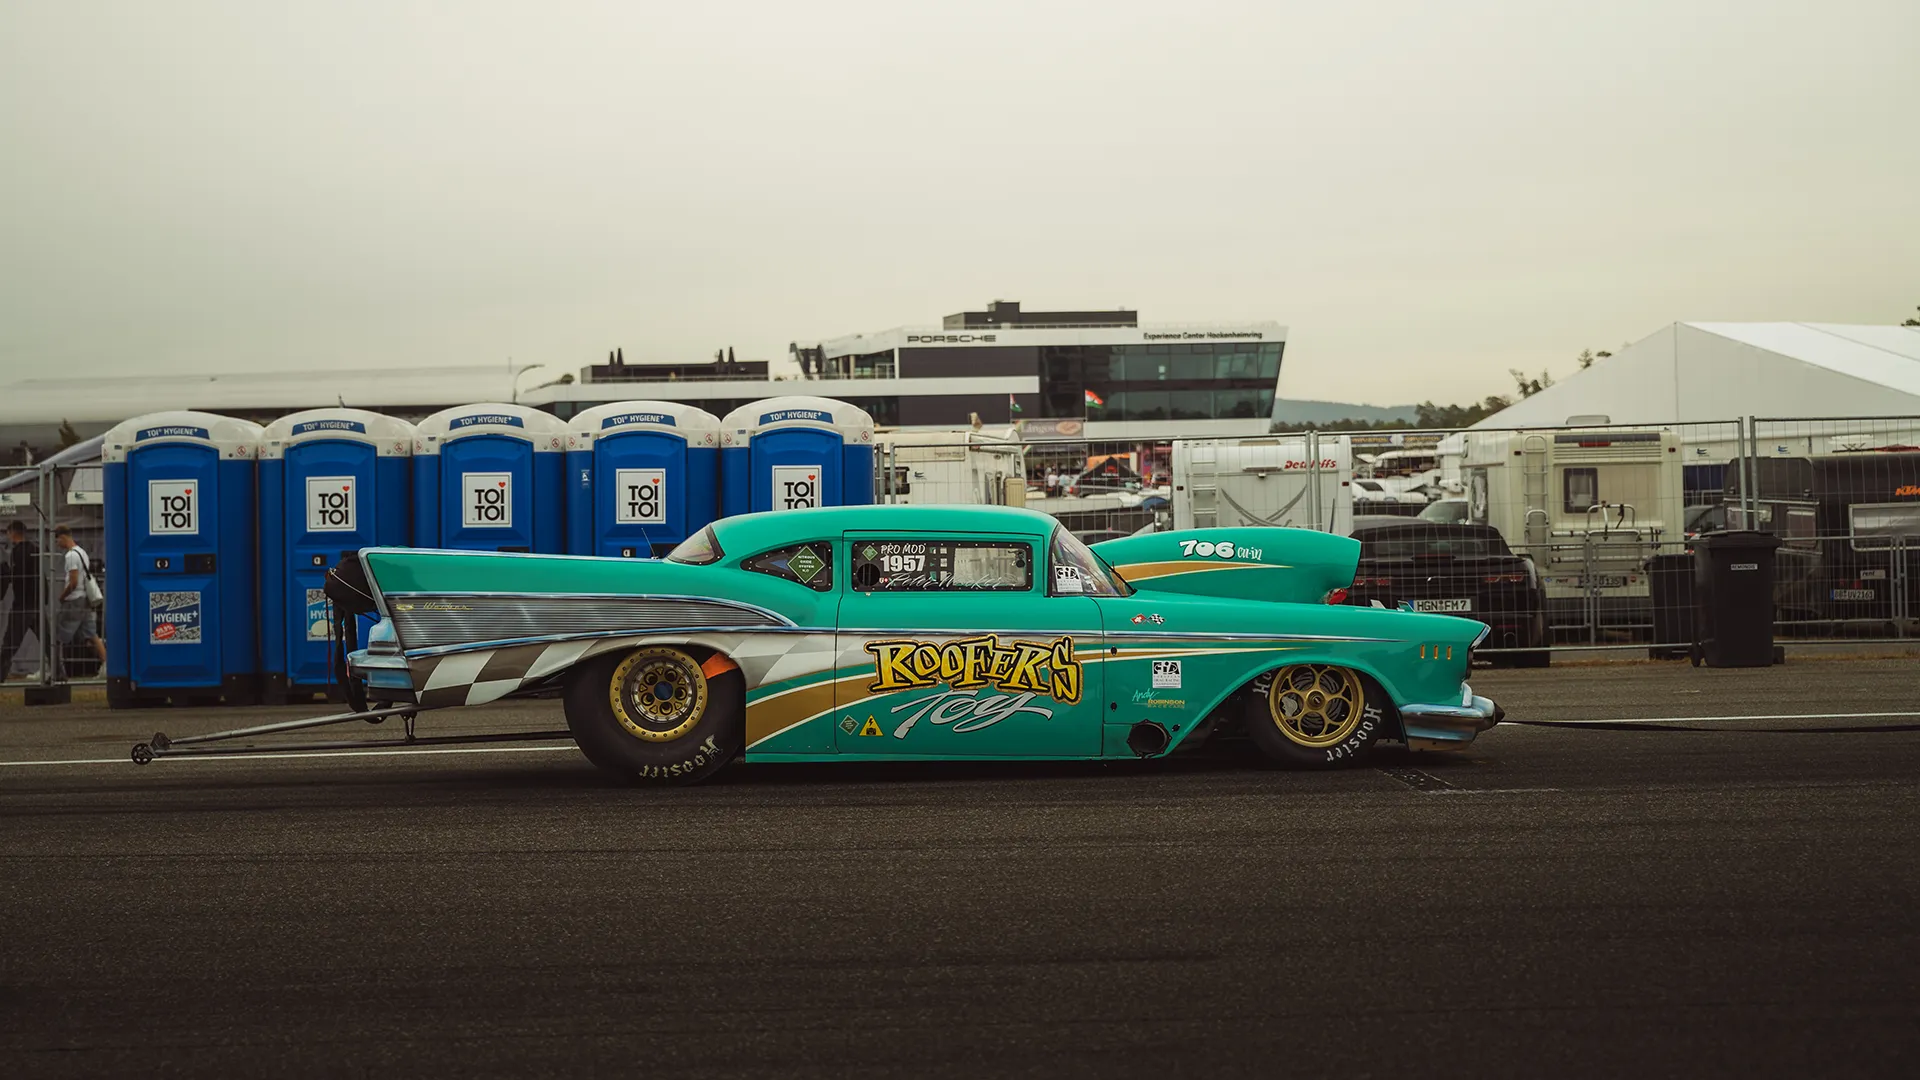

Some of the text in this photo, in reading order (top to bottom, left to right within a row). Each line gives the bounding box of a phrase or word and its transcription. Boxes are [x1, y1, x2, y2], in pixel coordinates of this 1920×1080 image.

[907, 335, 996, 343] PORSCHE
[1143, 332, 1181, 340] Experience
[475, 489, 504, 504] TOI
[628, 485, 658, 500] TOI
[784, 481, 814, 497] TOI
[161, 496, 191, 511] TOI
[318, 493, 348, 508] TOI
[318, 509, 349, 525] TOI
[475, 505, 504, 521] TOI
[628, 501, 658, 517] TOI
[161, 512, 191, 528] TOI
[880, 544, 901, 554] PRO
[902, 544, 926, 554] MOD
[1179, 539, 1235, 559] 706
[880, 555, 926, 572] 1957
[1417, 600, 1438, 611] HGN
[1444, 600, 1459, 610] FM
[866, 636, 1082, 704] ROOFERS
[891, 690, 1053, 739] Toy
[1326, 703, 1383, 762] Hoosier
[638, 734, 723, 778] Hoosier
